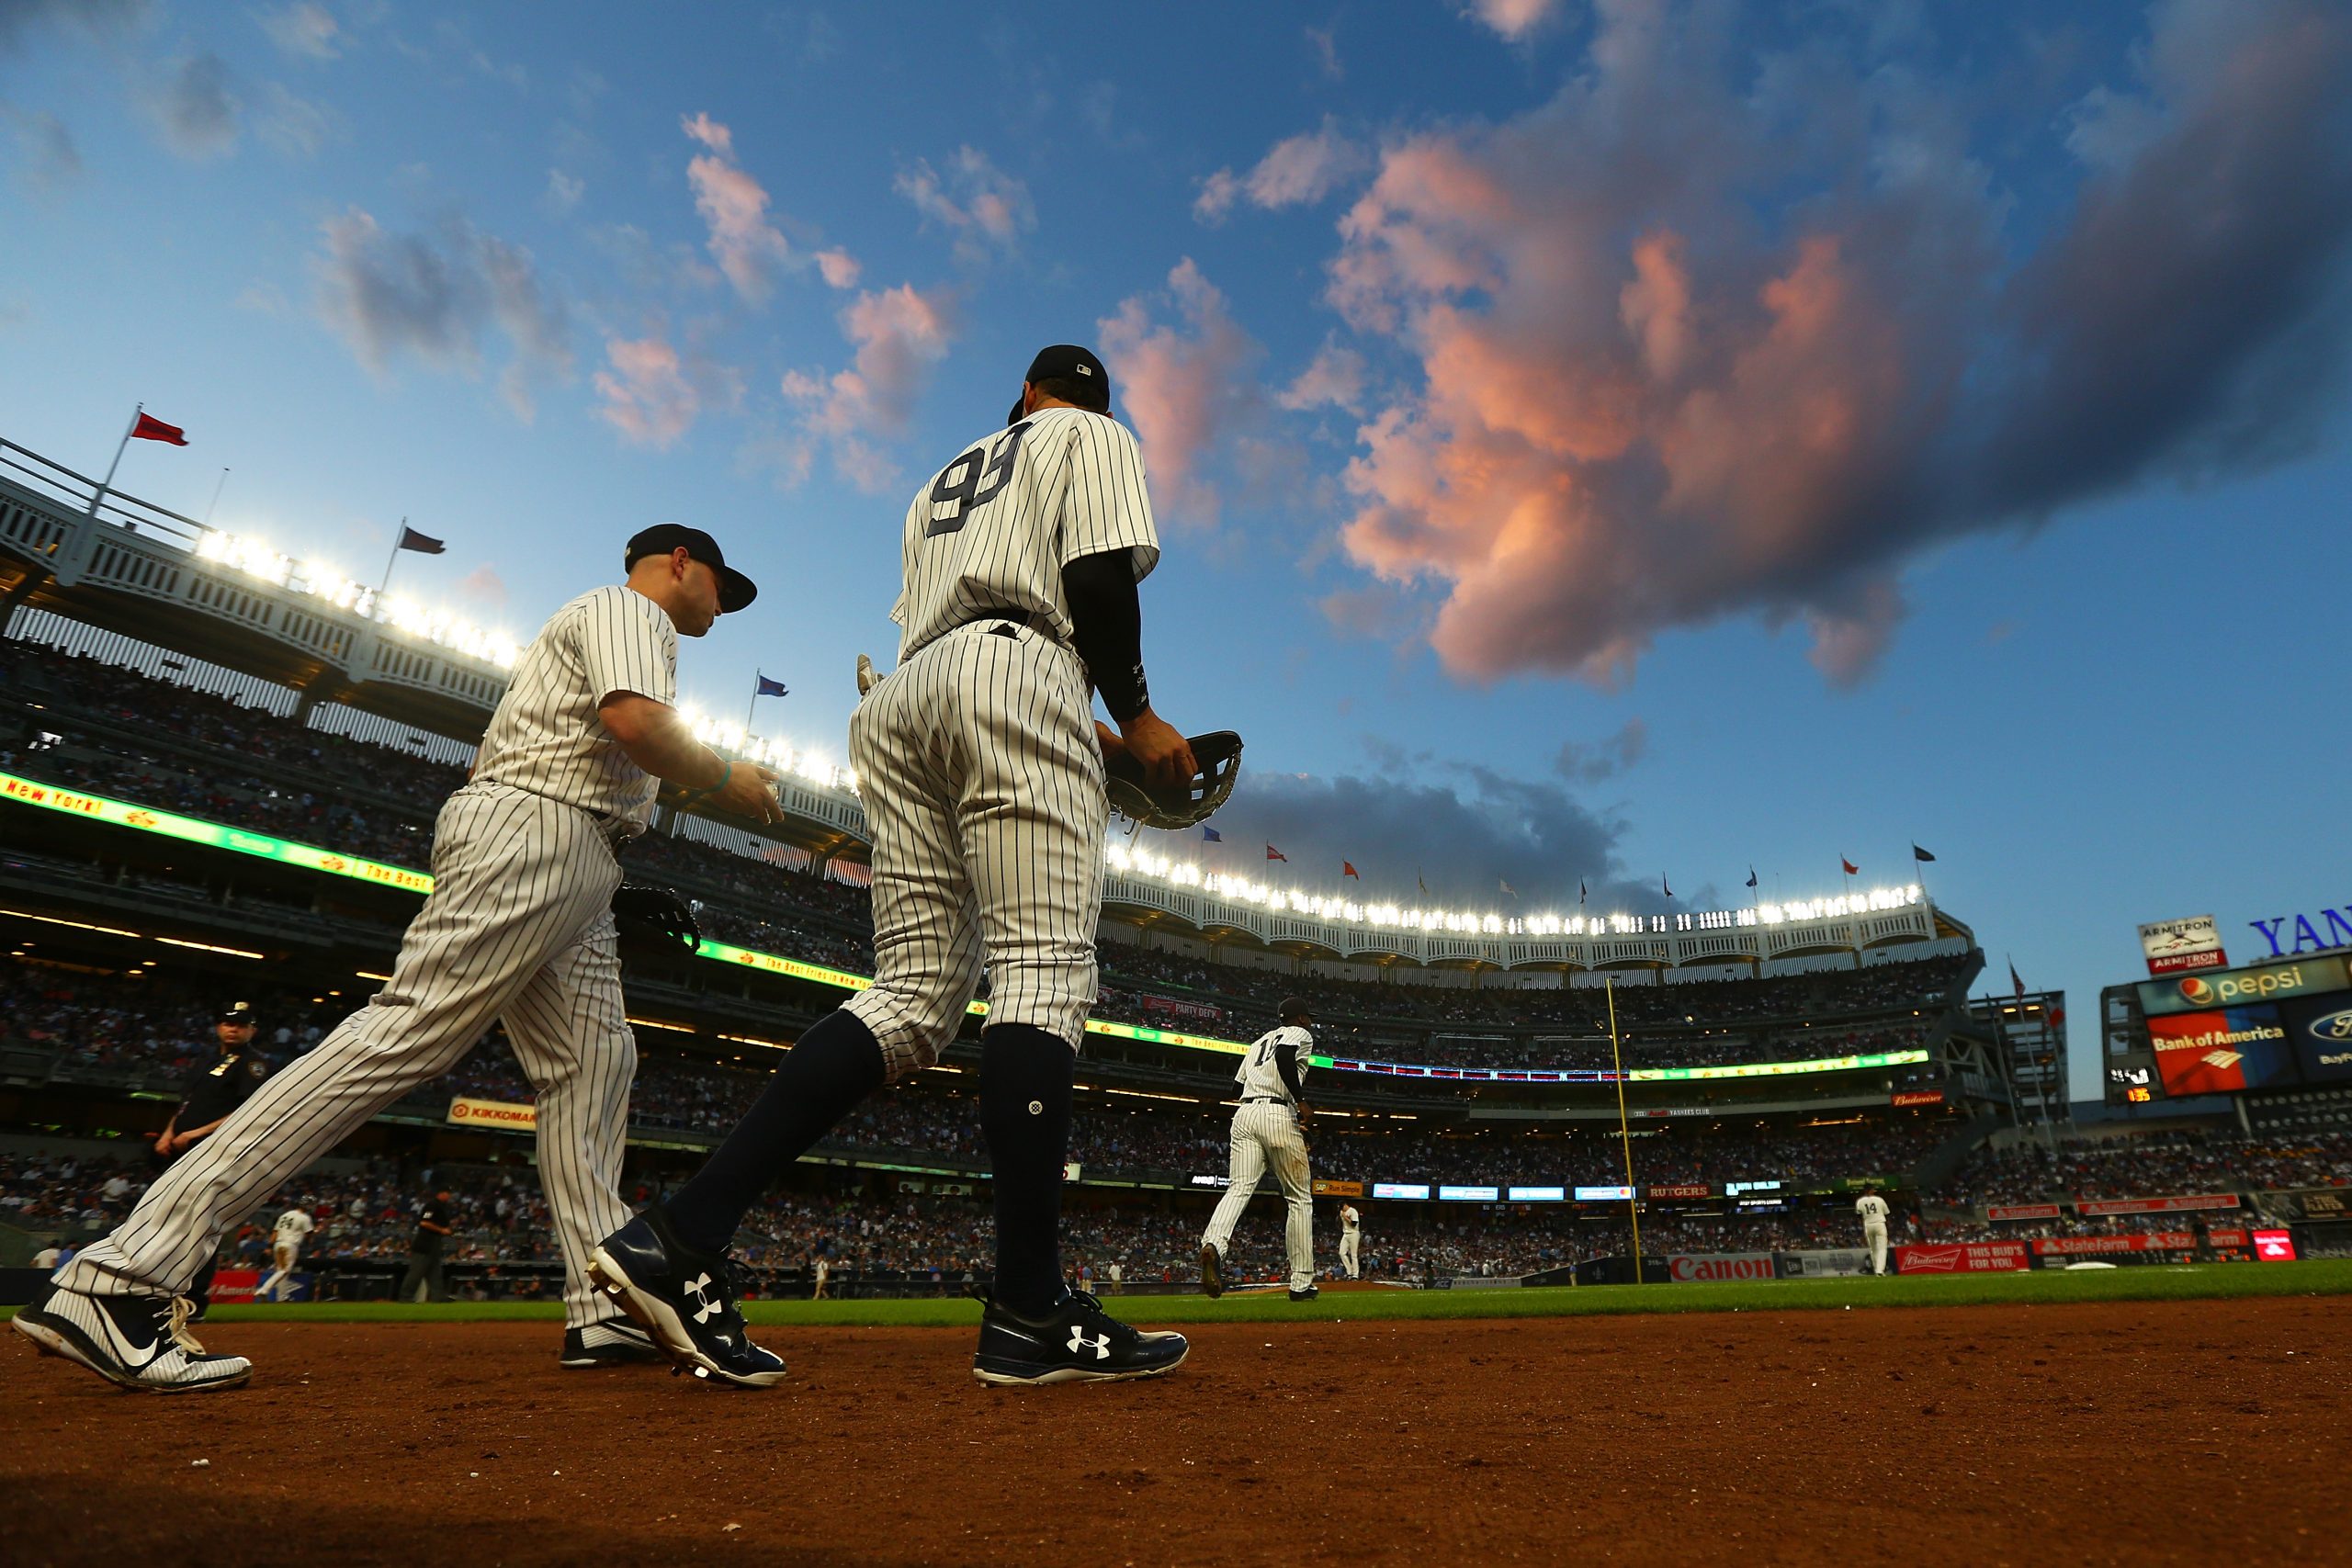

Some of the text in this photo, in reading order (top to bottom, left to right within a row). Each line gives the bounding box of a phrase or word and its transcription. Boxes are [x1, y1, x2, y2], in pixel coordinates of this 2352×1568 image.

[926, 422, 1033, 538] 99
[6, 780, 45, 801] New
[367, 864, 427, 888] The Best
[2144, 919, 2212, 937] ARMITRON
[2155, 952, 2218, 967] ARMITRON
[766, 958, 781, 969] The
[785, 963, 804, 975] Best
[806, 967, 827, 980] Fries
[829, 972, 837, 982] in
[840, 976, 855, 986] New
[2218, 965, 2303, 1002] pepsi
[2153, 1025, 2285, 1052] Bank of America
[1894, 1094, 1942, 1106] Budweiser
[1341, 1185, 1360, 1193] Simple
[1650, 1187, 1707, 1197] RUTGERS
[1864, 1202, 1877, 1214] 14
[1967, 1246, 2024, 1258] THIS BUD'S
[1905, 1255, 1956, 1266] Budweiser
[1969, 1258, 2017, 1269] FOR YOU.
[1670, 1257, 1773, 1281] Canon
